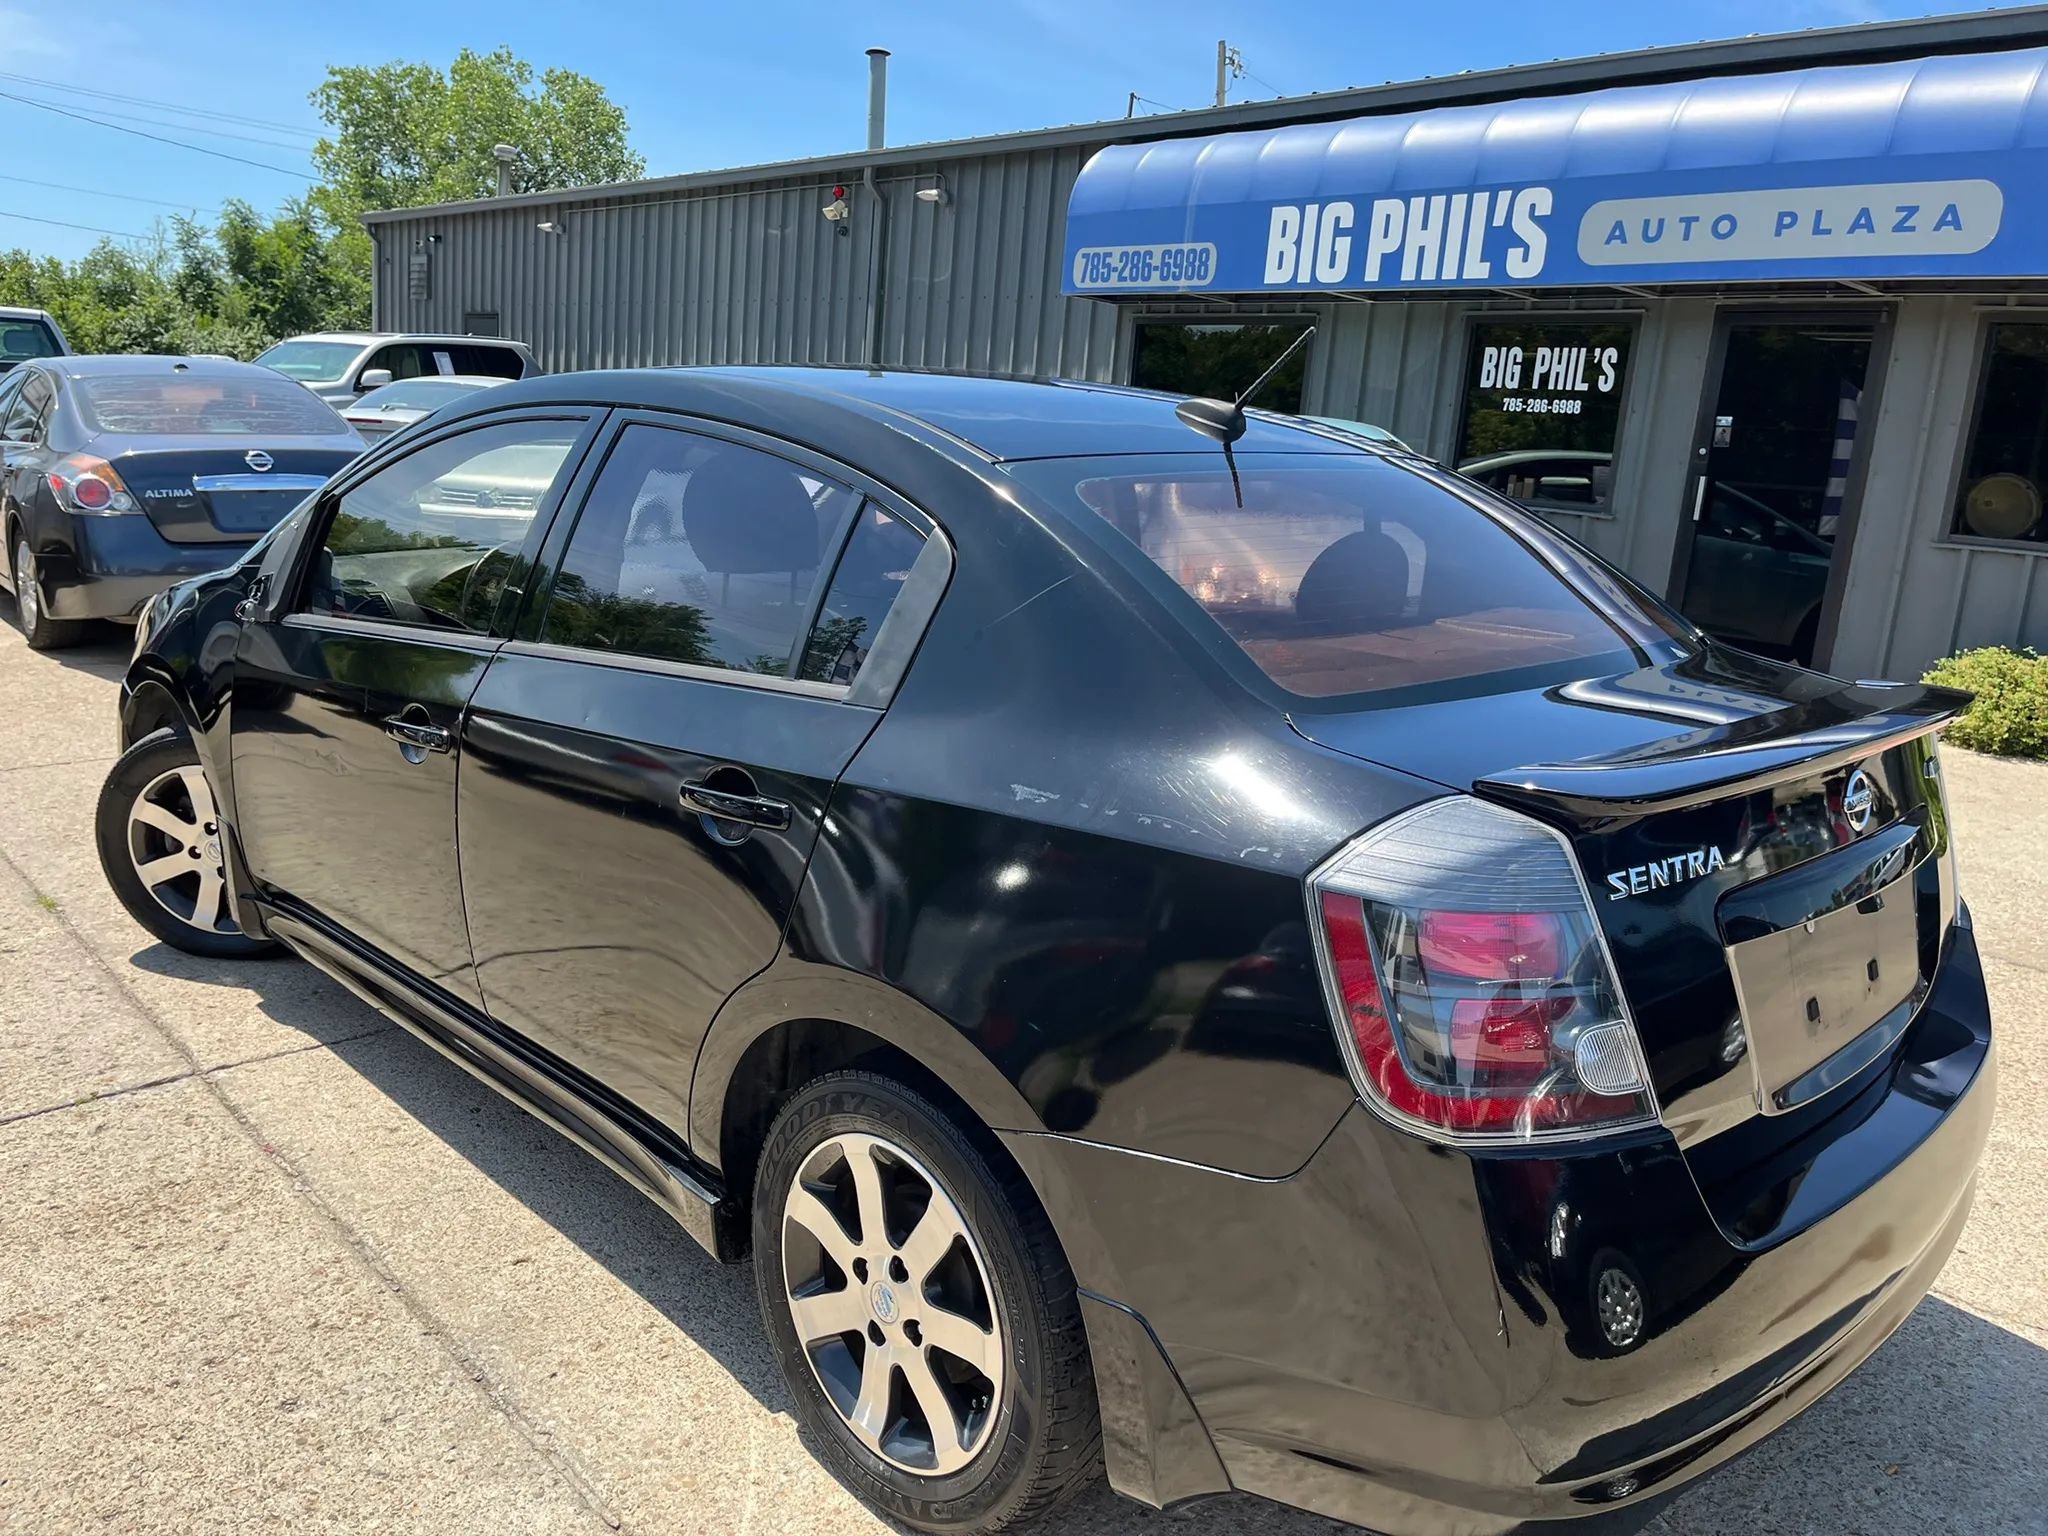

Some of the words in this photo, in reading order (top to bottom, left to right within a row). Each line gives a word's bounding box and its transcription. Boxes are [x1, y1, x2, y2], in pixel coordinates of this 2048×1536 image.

[1264, 201, 1354, 284] BIG
[1364, 187, 1553, 282] PHIL'S
[1604, 213, 1738, 246] AUTO
[1773, 203, 1963, 238] PLAZA
[1080, 247, 1210, 284] 785-286-6988
[1480, 346, 1523, 390] BIG
[1532, 346, 1618, 392] PHIL'S
[1502, 397, 1582, 414] 785-286-6988
[145, 488, 193, 499] ALTIMA
[1606, 845, 1726, 901] SENTRA
